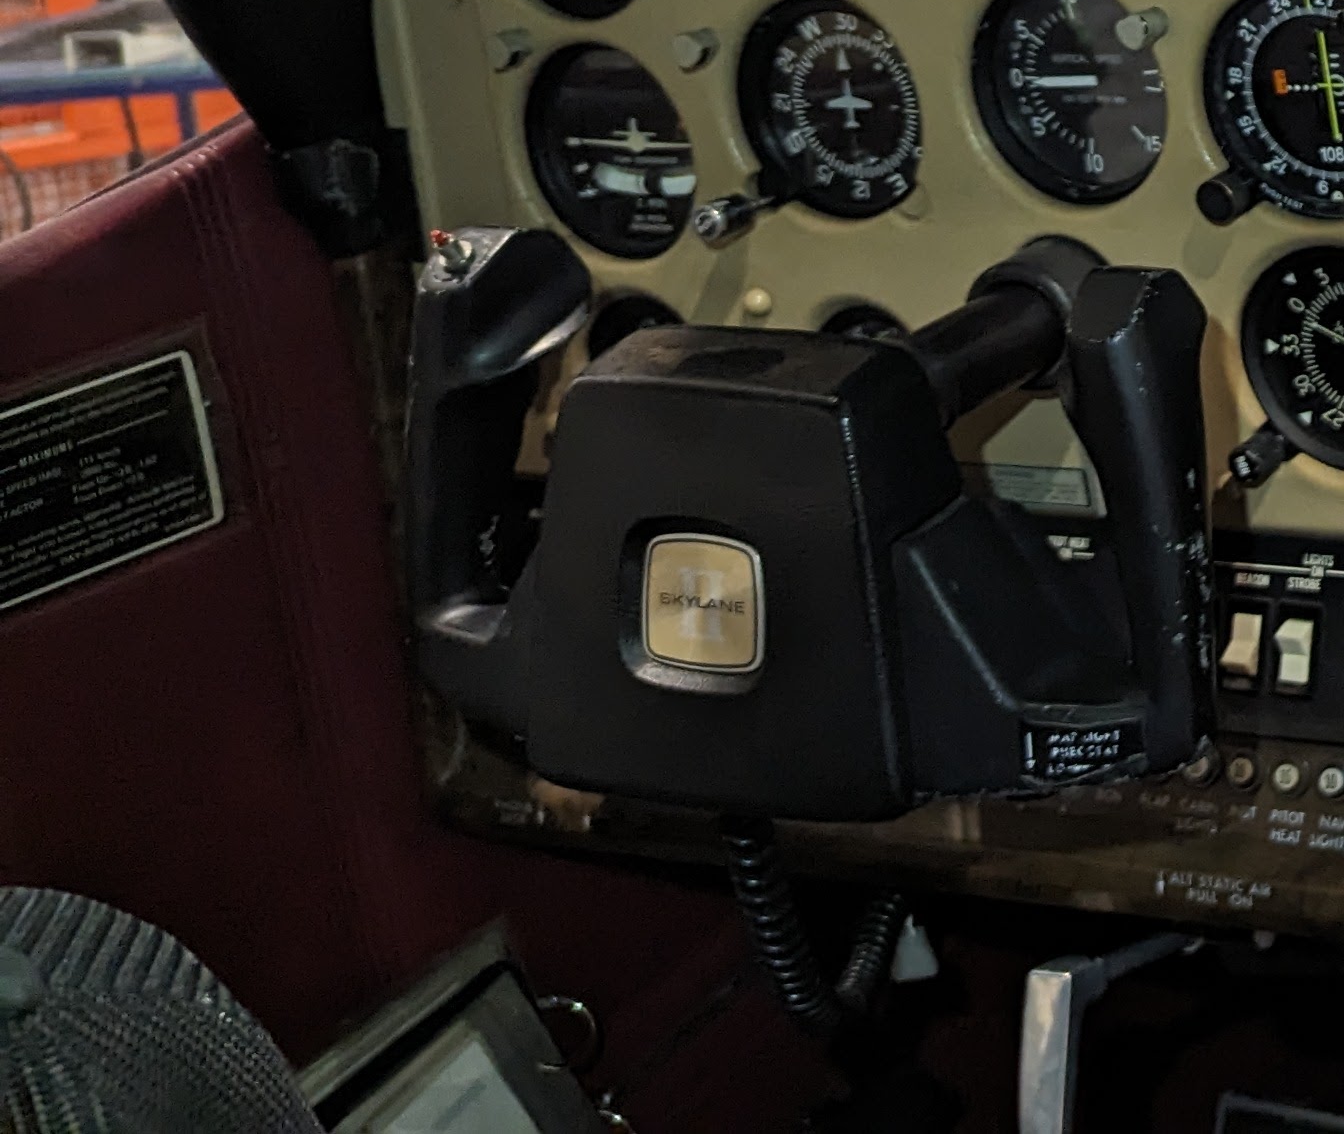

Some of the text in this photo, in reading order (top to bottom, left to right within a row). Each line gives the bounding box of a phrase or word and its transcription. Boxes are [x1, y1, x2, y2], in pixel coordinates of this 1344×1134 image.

[1303, 555, 1334, 566] LIGHTS
[1287, 577, 1321, 591] STROBE
[660, 592, 745, 614] SKYLANE
[1169, 873, 1271, 897] ALT STATIC AIR
